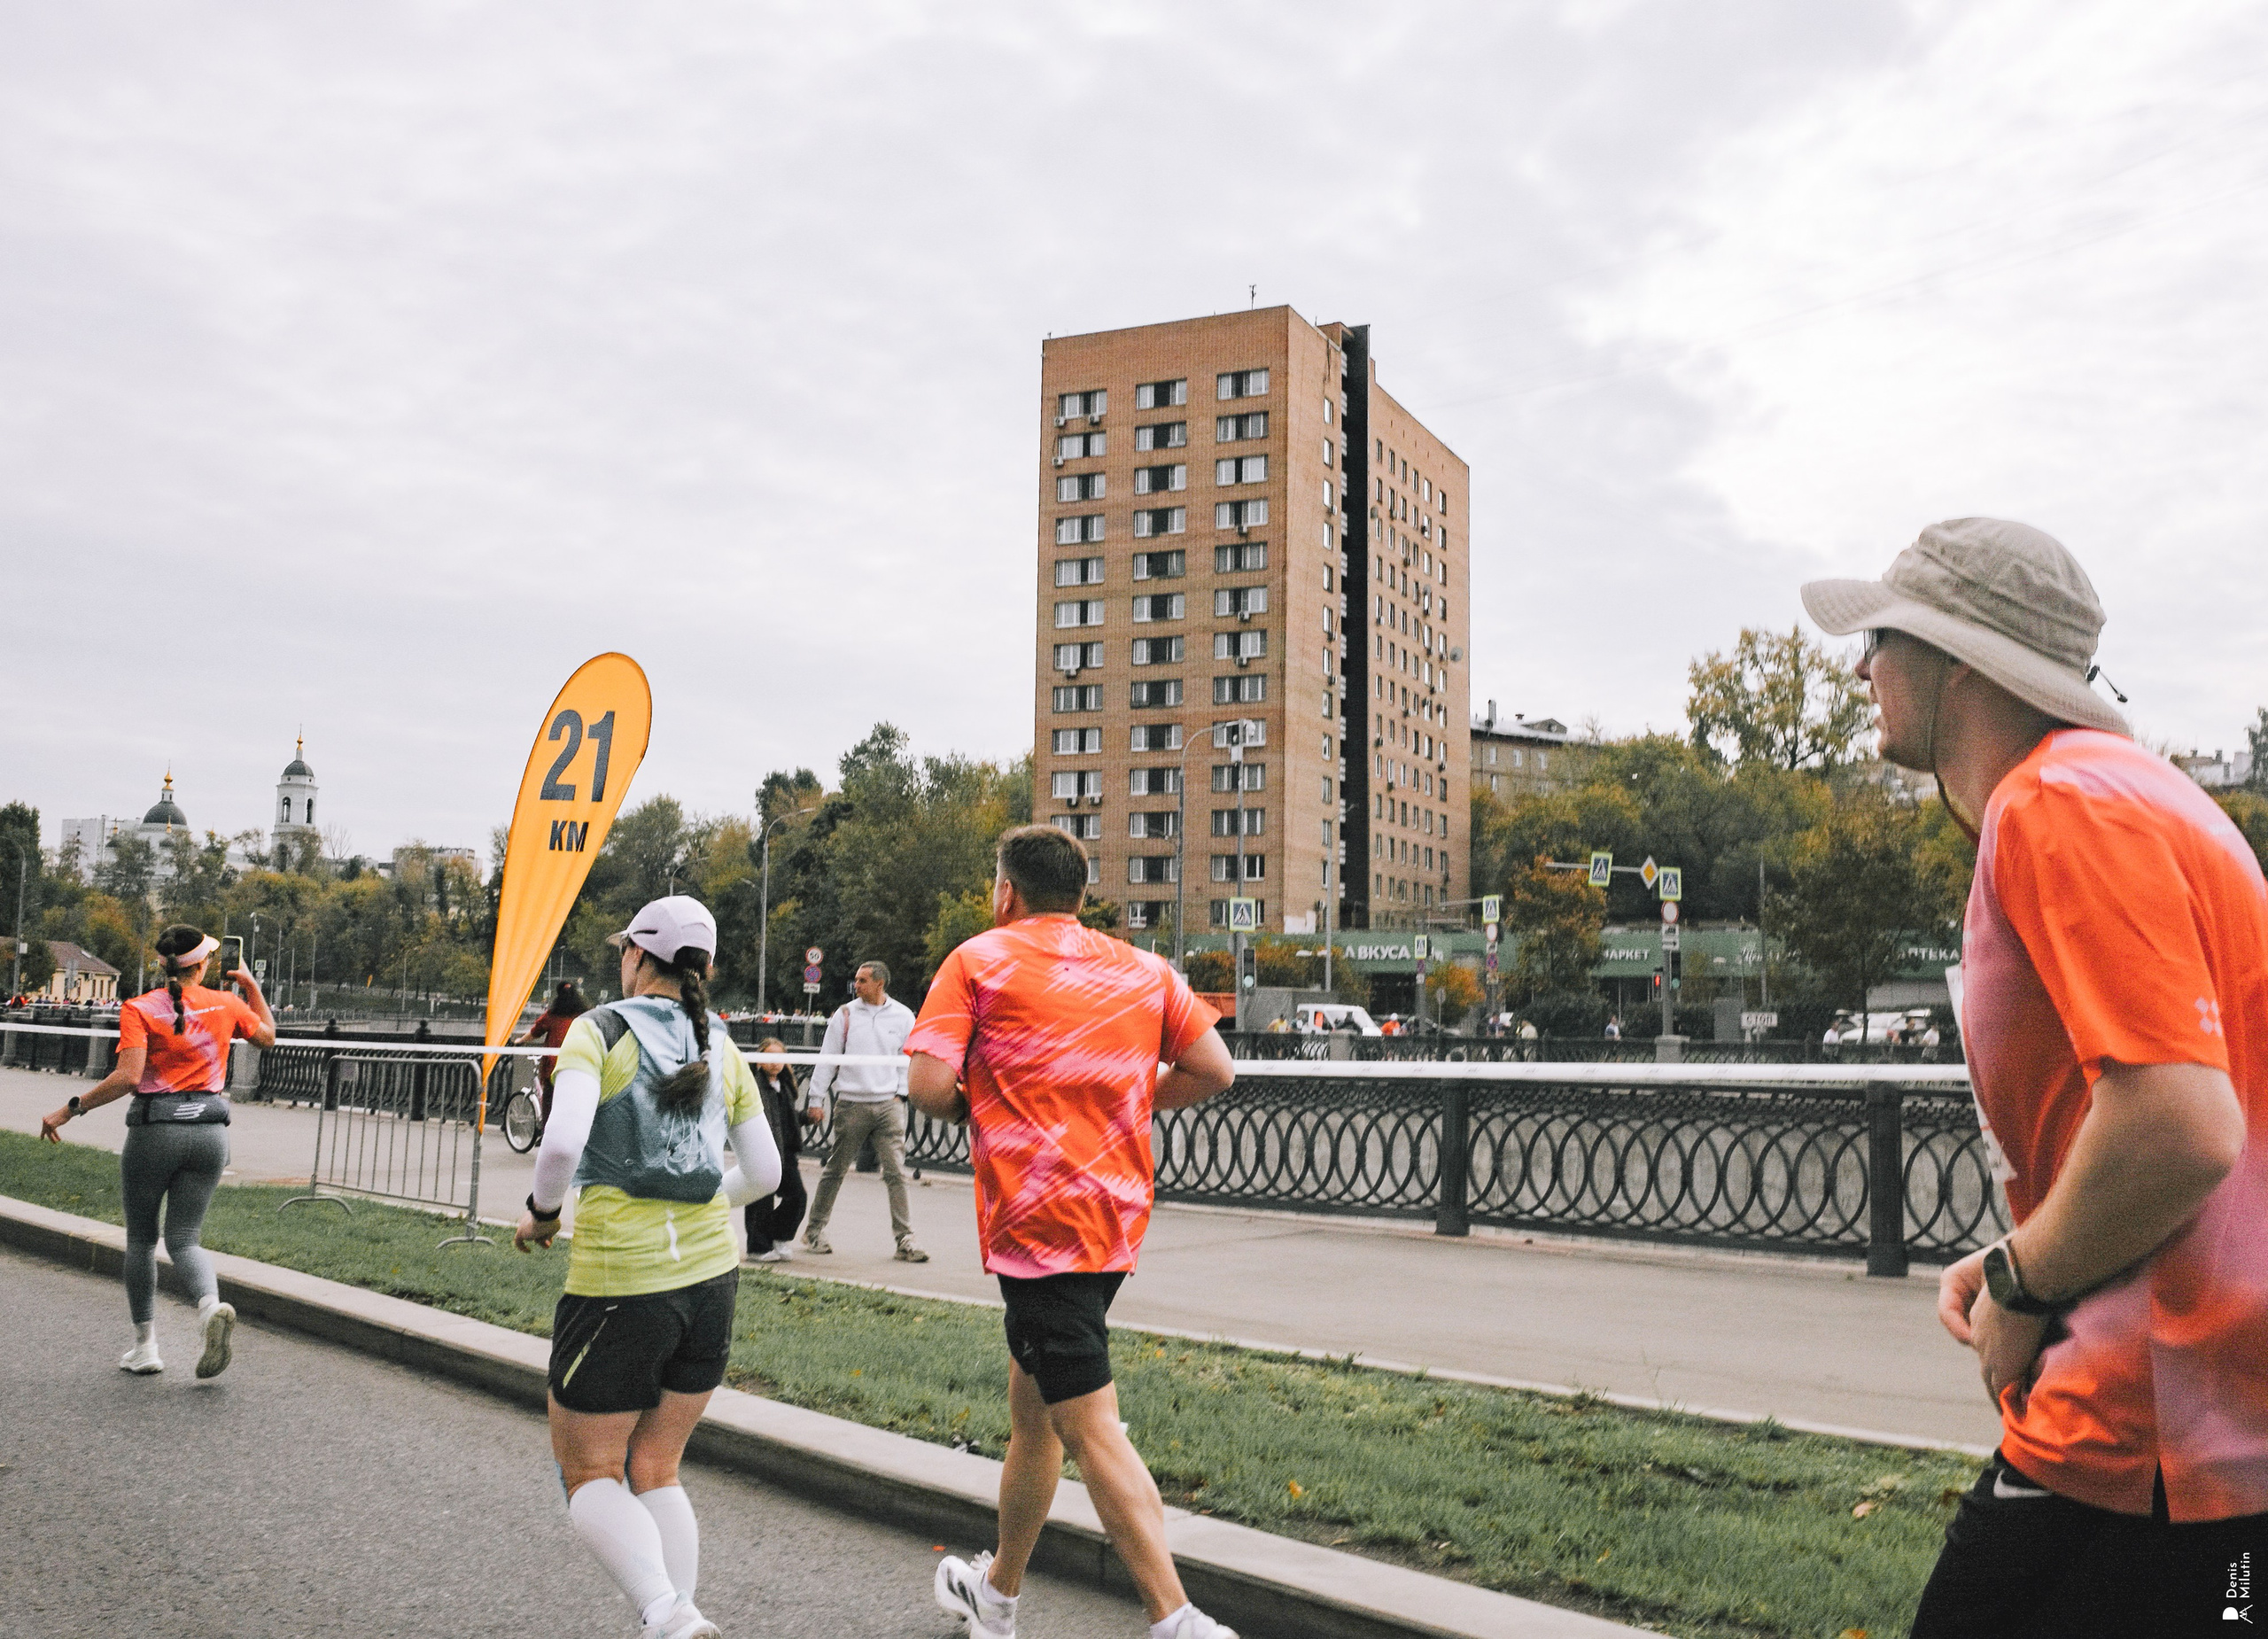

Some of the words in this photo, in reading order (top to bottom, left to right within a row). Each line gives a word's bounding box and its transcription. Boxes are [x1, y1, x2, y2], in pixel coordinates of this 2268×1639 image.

[540, 709, 615, 802] 21
[549, 820, 589, 852] KM
[1357, 944, 1411, 960] ВКУСА
